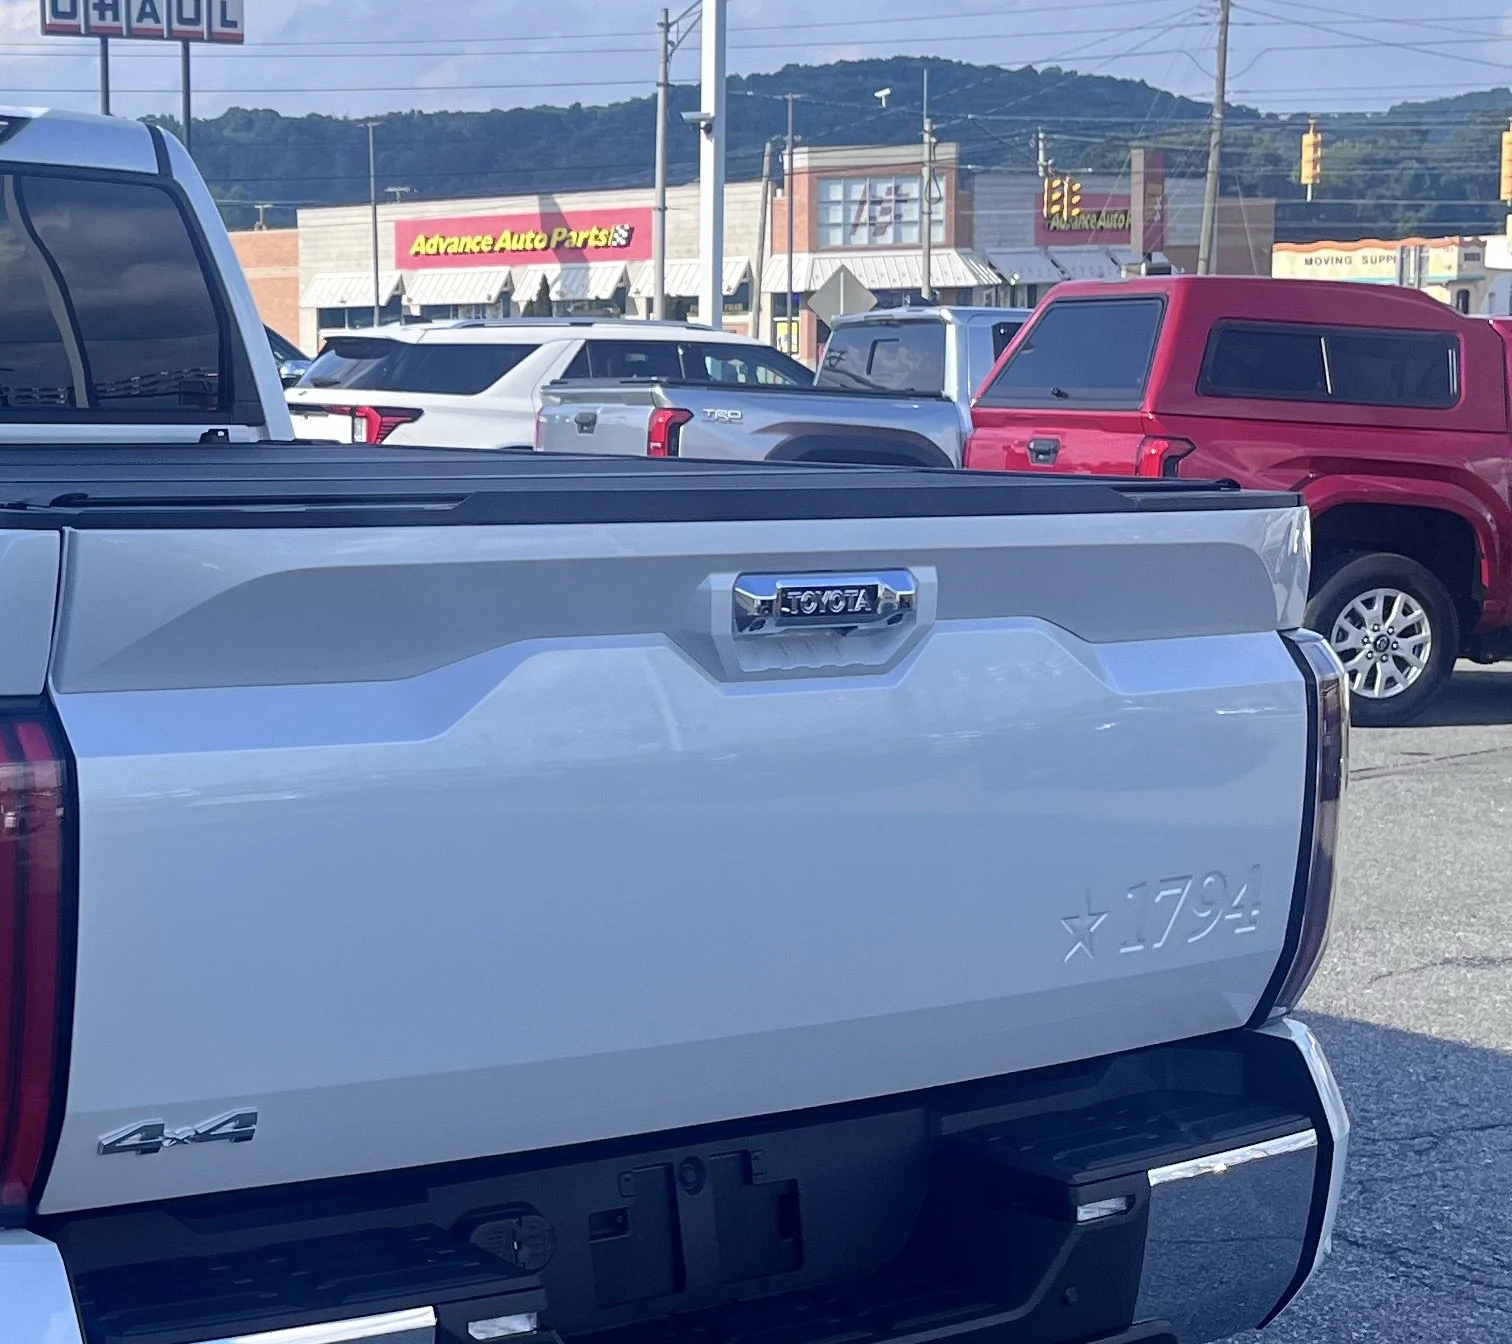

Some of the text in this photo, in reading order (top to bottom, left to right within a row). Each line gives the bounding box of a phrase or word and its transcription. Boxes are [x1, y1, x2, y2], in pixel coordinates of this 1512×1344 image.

[1097, 209, 1126, 230] Auto
[410, 226, 610, 256] Advance Auto Parts
[1304, 256, 1353, 266] MOVING
[702, 408, 742, 421] TRD
[786, 589, 872, 615] TOYOTA
[1118, 863, 1261, 954] 1794
